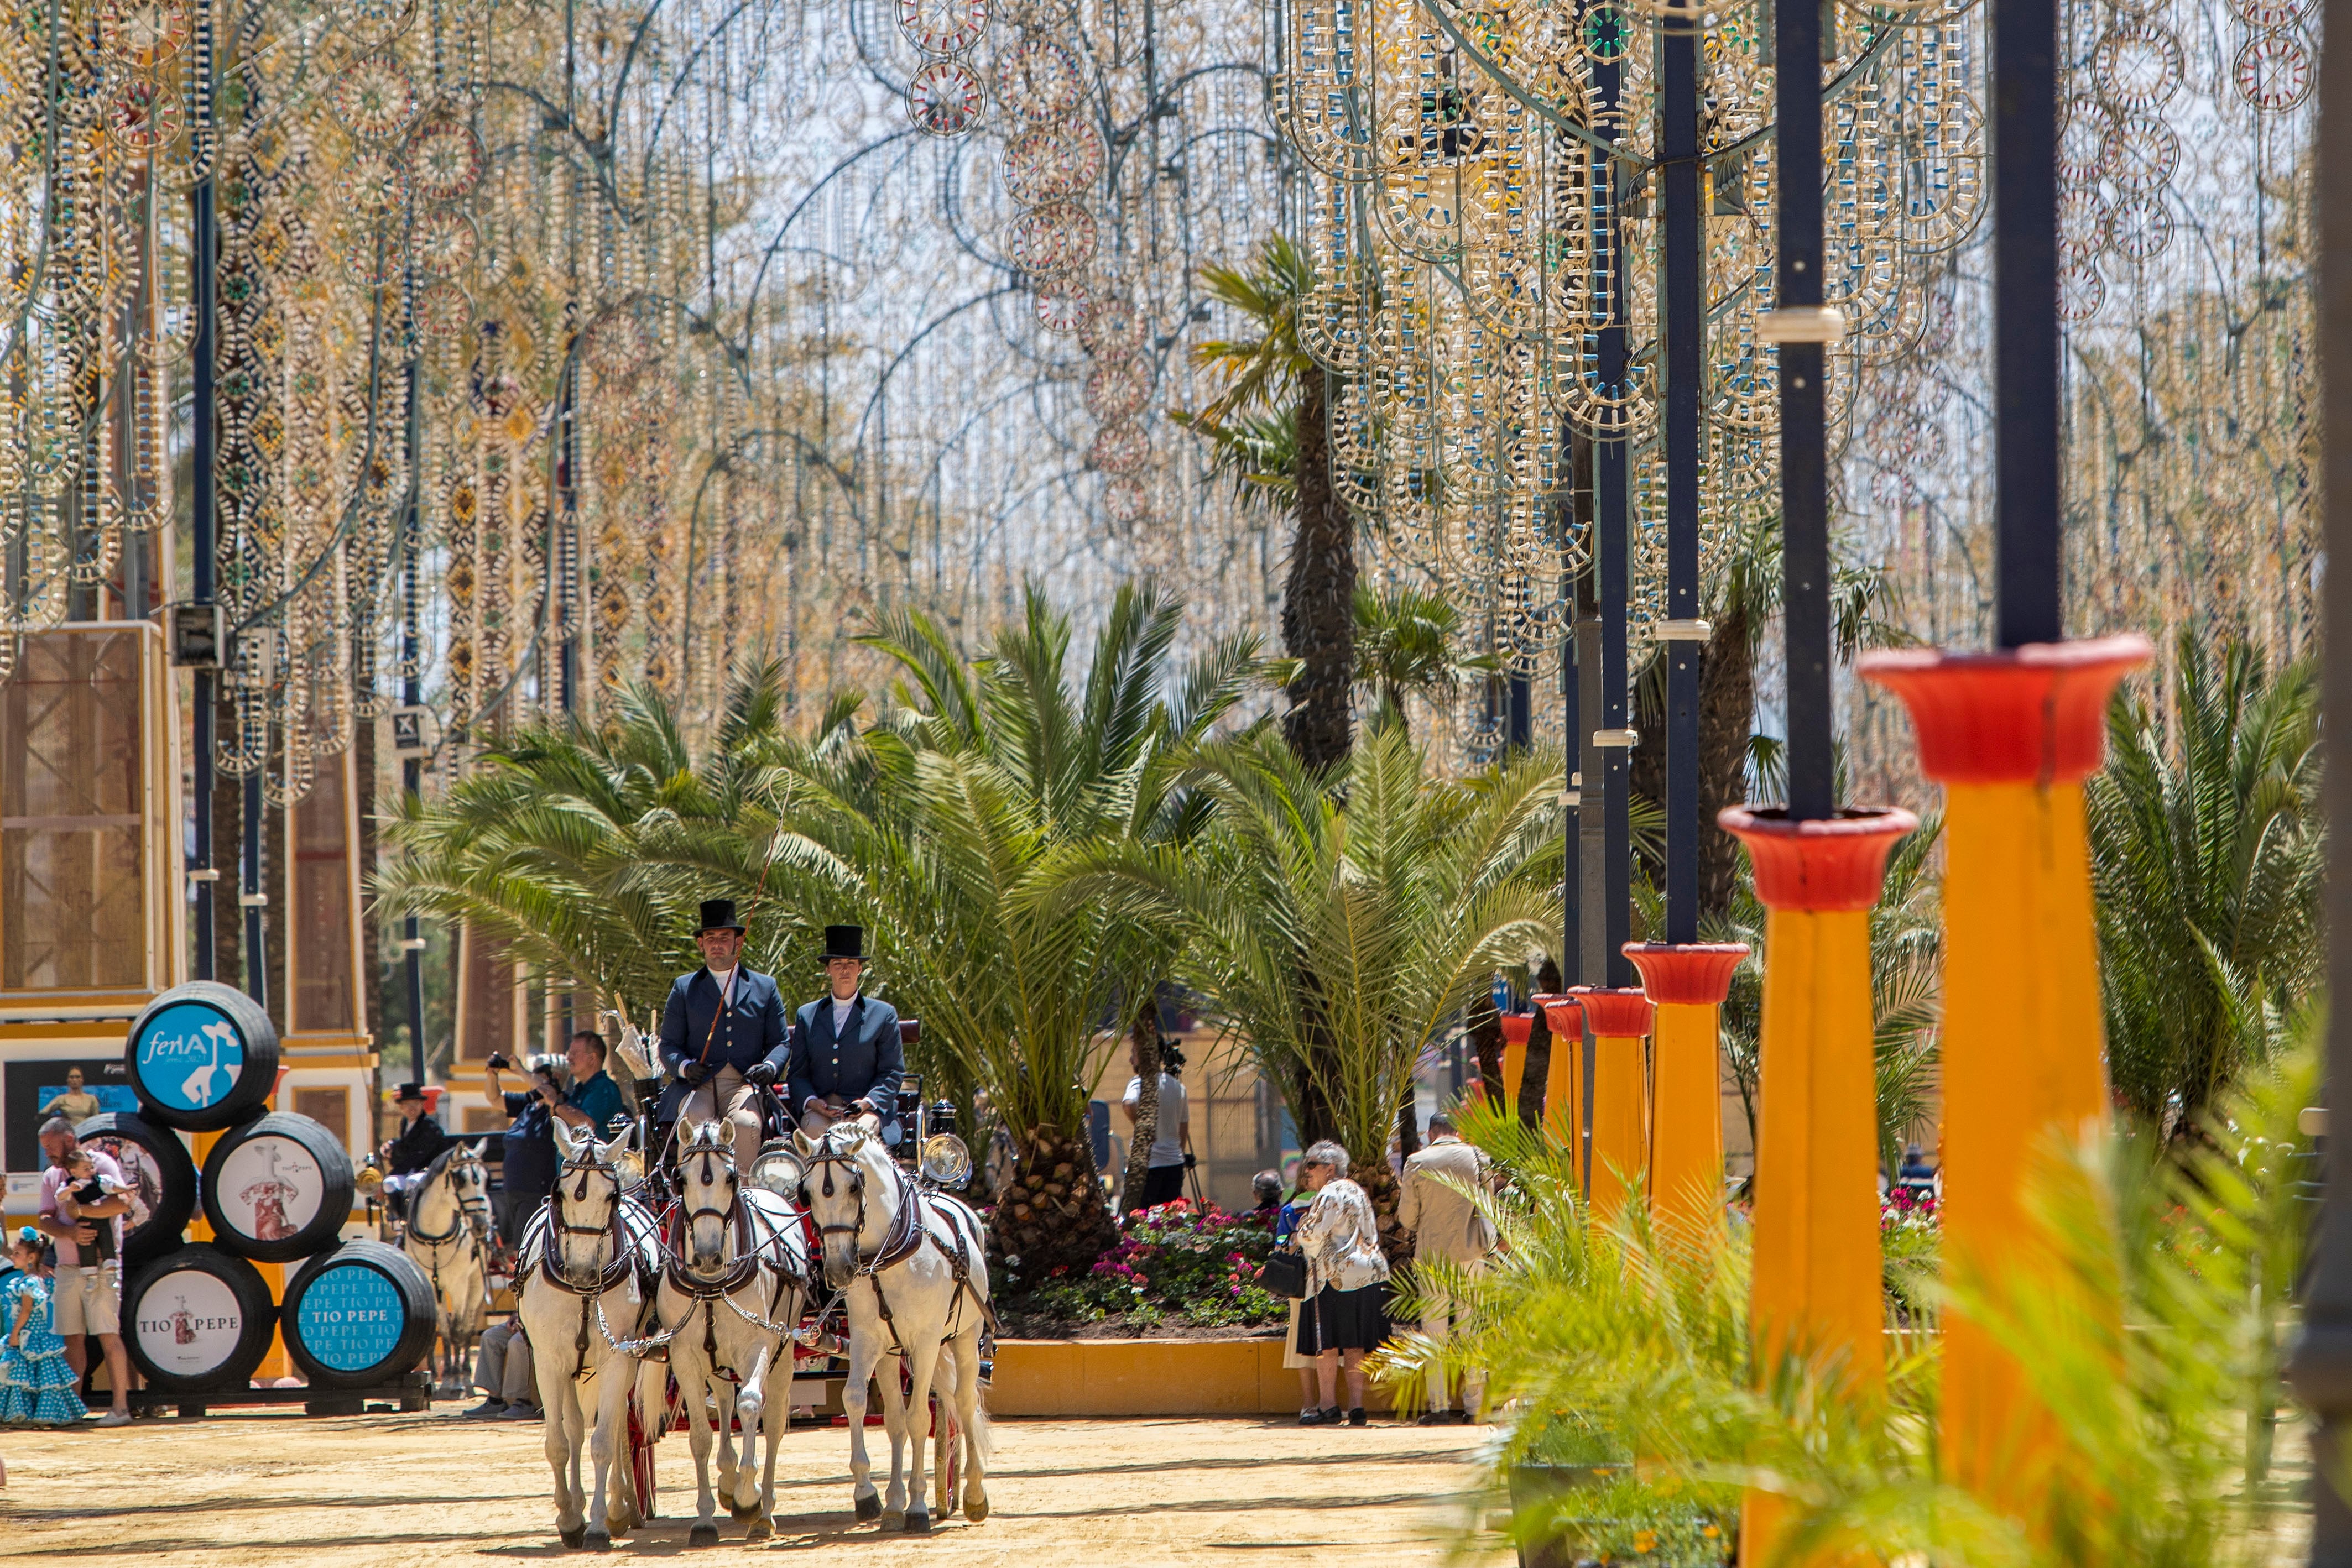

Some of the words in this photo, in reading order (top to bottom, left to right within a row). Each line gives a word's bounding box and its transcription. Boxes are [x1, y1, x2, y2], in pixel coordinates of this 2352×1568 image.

[315, 1269, 341, 1282] IO
[347, 1269, 386, 1280] PEP
[320, 1283, 359, 1295] PEPE
[367, 1282, 396, 1294] TIO
[304, 1298, 332, 1310] EPE
[340, 1296, 368, 1308] TIO
[311, 1310, 342, 1323] TIO
[347, 1309, 388, 1322] PEPE
[140, 1320, 171, 1332] TIO
[195, 1317, 238, 1330] PEPE
[303, 1326, 315, 1337] O
[320, 1325, 358, 1336] PEPE
[367, 1323, 396, 1335] TIO
[340, 1338, 369, 1350] TIO
[376, 1337, 399, 1349] PE
